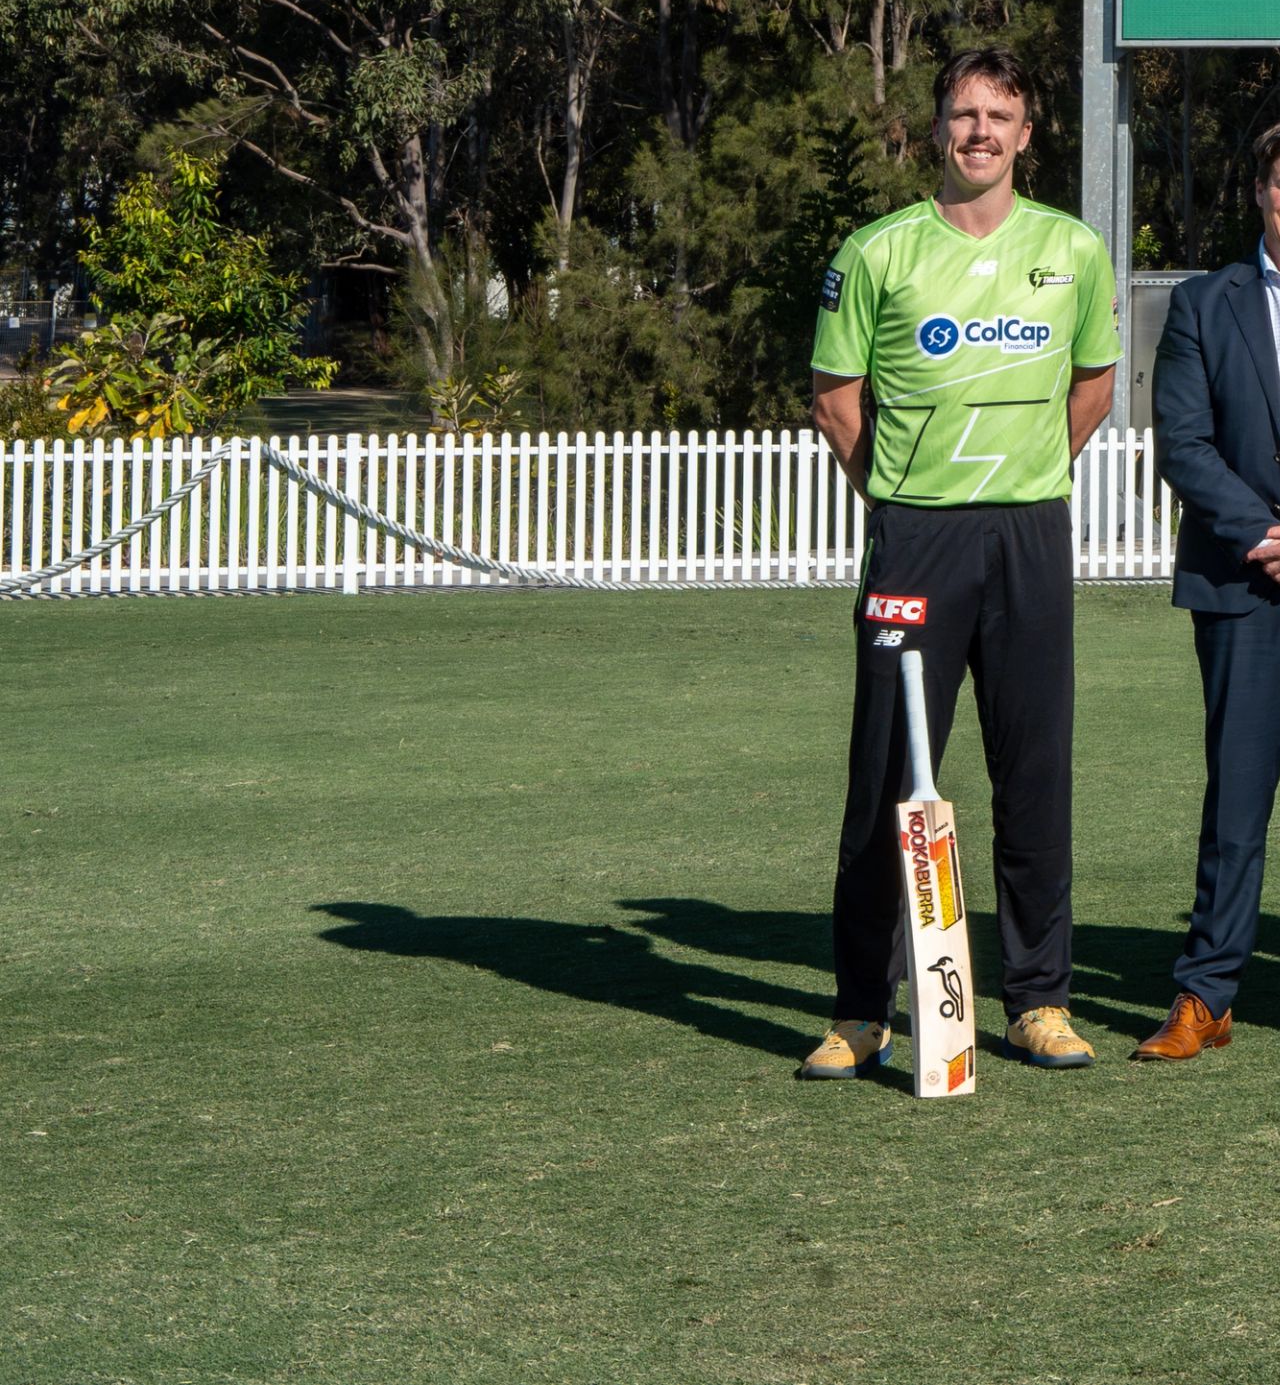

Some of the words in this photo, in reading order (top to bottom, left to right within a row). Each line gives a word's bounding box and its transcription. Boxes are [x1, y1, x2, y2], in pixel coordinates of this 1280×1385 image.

[965, 318, 1049, 347] ColCap
[866, 597, 923, 621] KFC
[908, 810, 936, 930] KOOKABURRA
